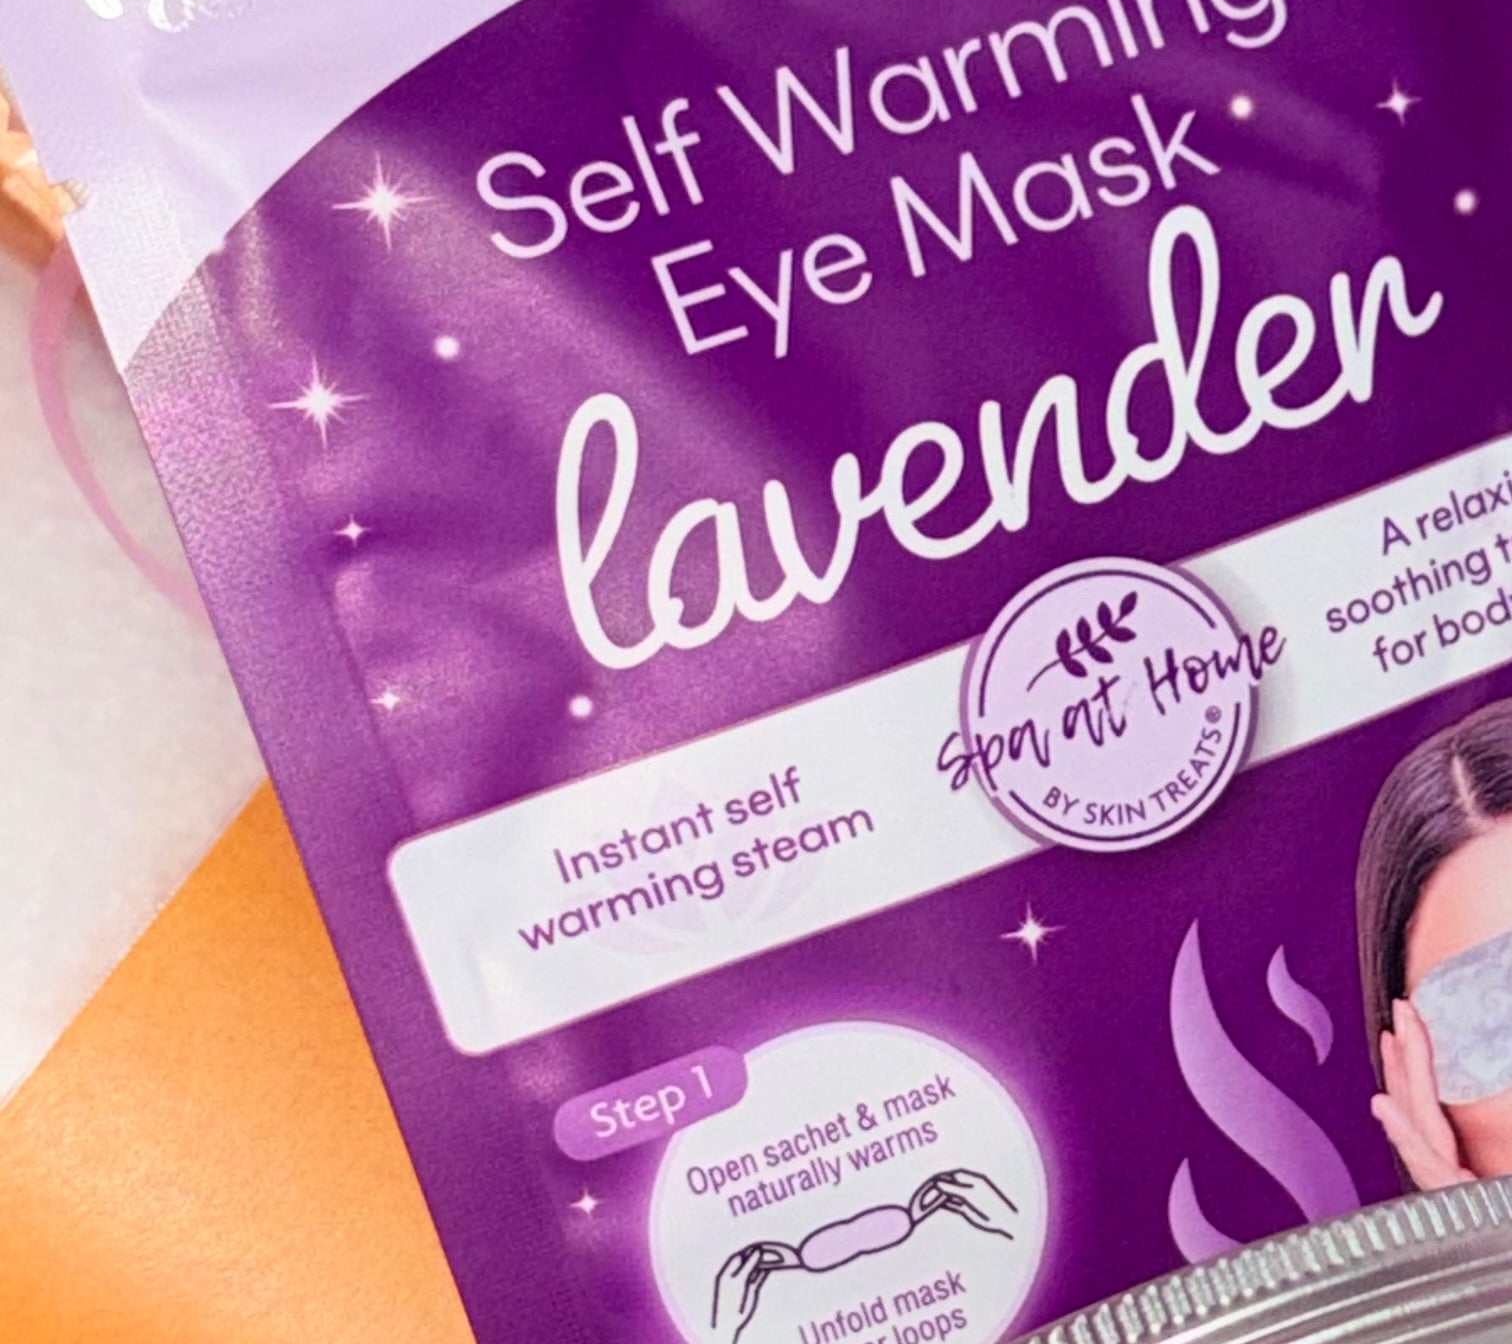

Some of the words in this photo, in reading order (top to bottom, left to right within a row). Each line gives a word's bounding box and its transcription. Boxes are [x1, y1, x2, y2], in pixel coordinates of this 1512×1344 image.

[475, 96, 705, 260] Self
[651, 231, 873, 359] Eye
[890, 94, 1221, 279] Mask
[556, 204, 1443, 669] lavender
[1381, 516, 1411, 556] A
[1325, 547, 1493, 634] soothing
[1062, 675, 1126, 747] at
[1144, 625, 1287, 716] Home
[1372, 629, 1427, 674] for
[553, 802, 715, 884] Instant
[724, 764, 802, 825] self
[1043, 786, 1080, 816] BY
[1083, 799, 1147, 827] SKIN
[518, 861, 725, 952] warming
[731, 808, 874, 878] steam
[589, 1083, 688, 1139] Step
[693, 1066, 714, 1098] 1
[686, 1160, 759, 1200] Open
[763, 1114, 853, 1167] sachet
[856, 1103, 879, 1131] &
[883, 1074, 958, 1121] mask
[727, 1155, 844, 1218] naturally
[849, 1121, 940, 1172] warms
[893, 1269, 968, 1314] mask
